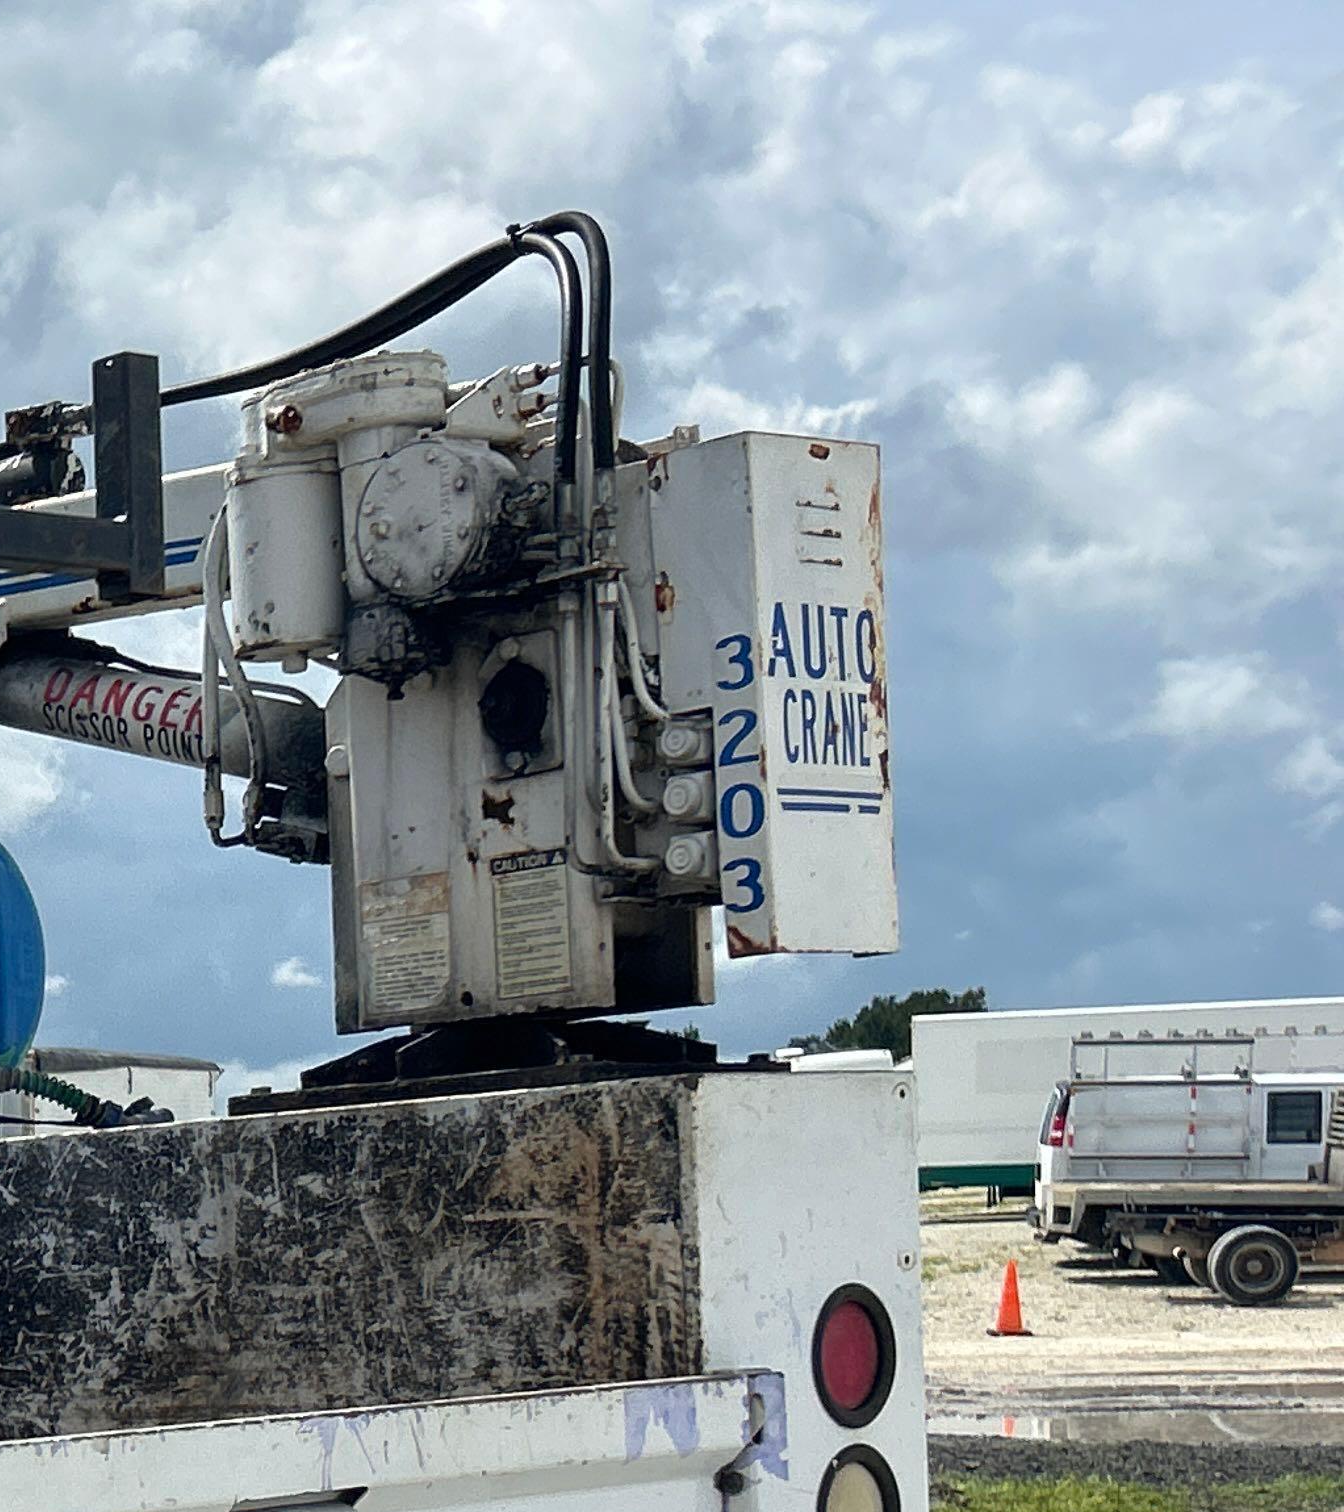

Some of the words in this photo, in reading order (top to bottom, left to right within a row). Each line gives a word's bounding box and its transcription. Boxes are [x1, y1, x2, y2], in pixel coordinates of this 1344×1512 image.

[767, 601, 877, 684] AUTO
[42, 701, 132, 749] SCISSOR
[782, 688, 871, 767] CRANE
[715, 633, 766, 913] 3203
[492, 853, 548, 873] CAUTION
